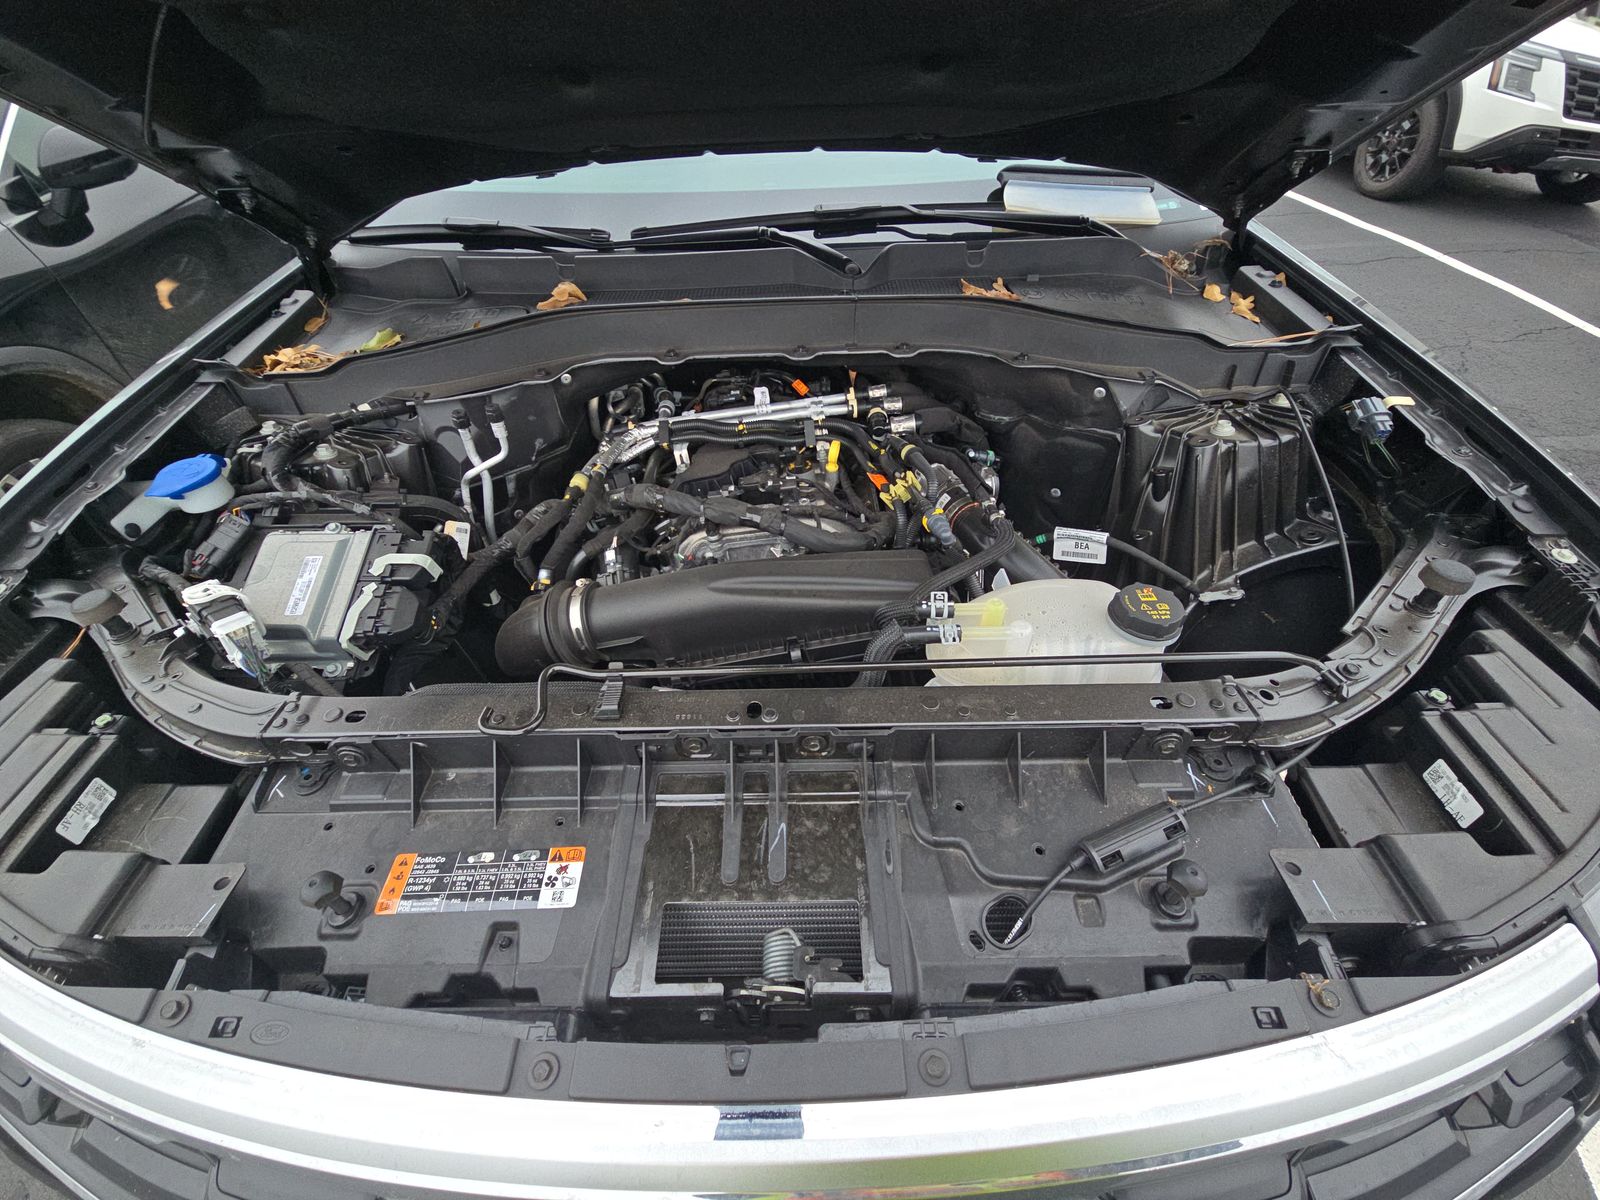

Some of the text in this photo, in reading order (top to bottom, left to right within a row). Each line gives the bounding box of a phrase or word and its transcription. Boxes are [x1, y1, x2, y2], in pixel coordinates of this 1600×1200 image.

[1074, 541, 1090, 550] BEA
[415, 855, 446, 864] FoMoCo
[407, 876, 437, 885] R-1234yf
